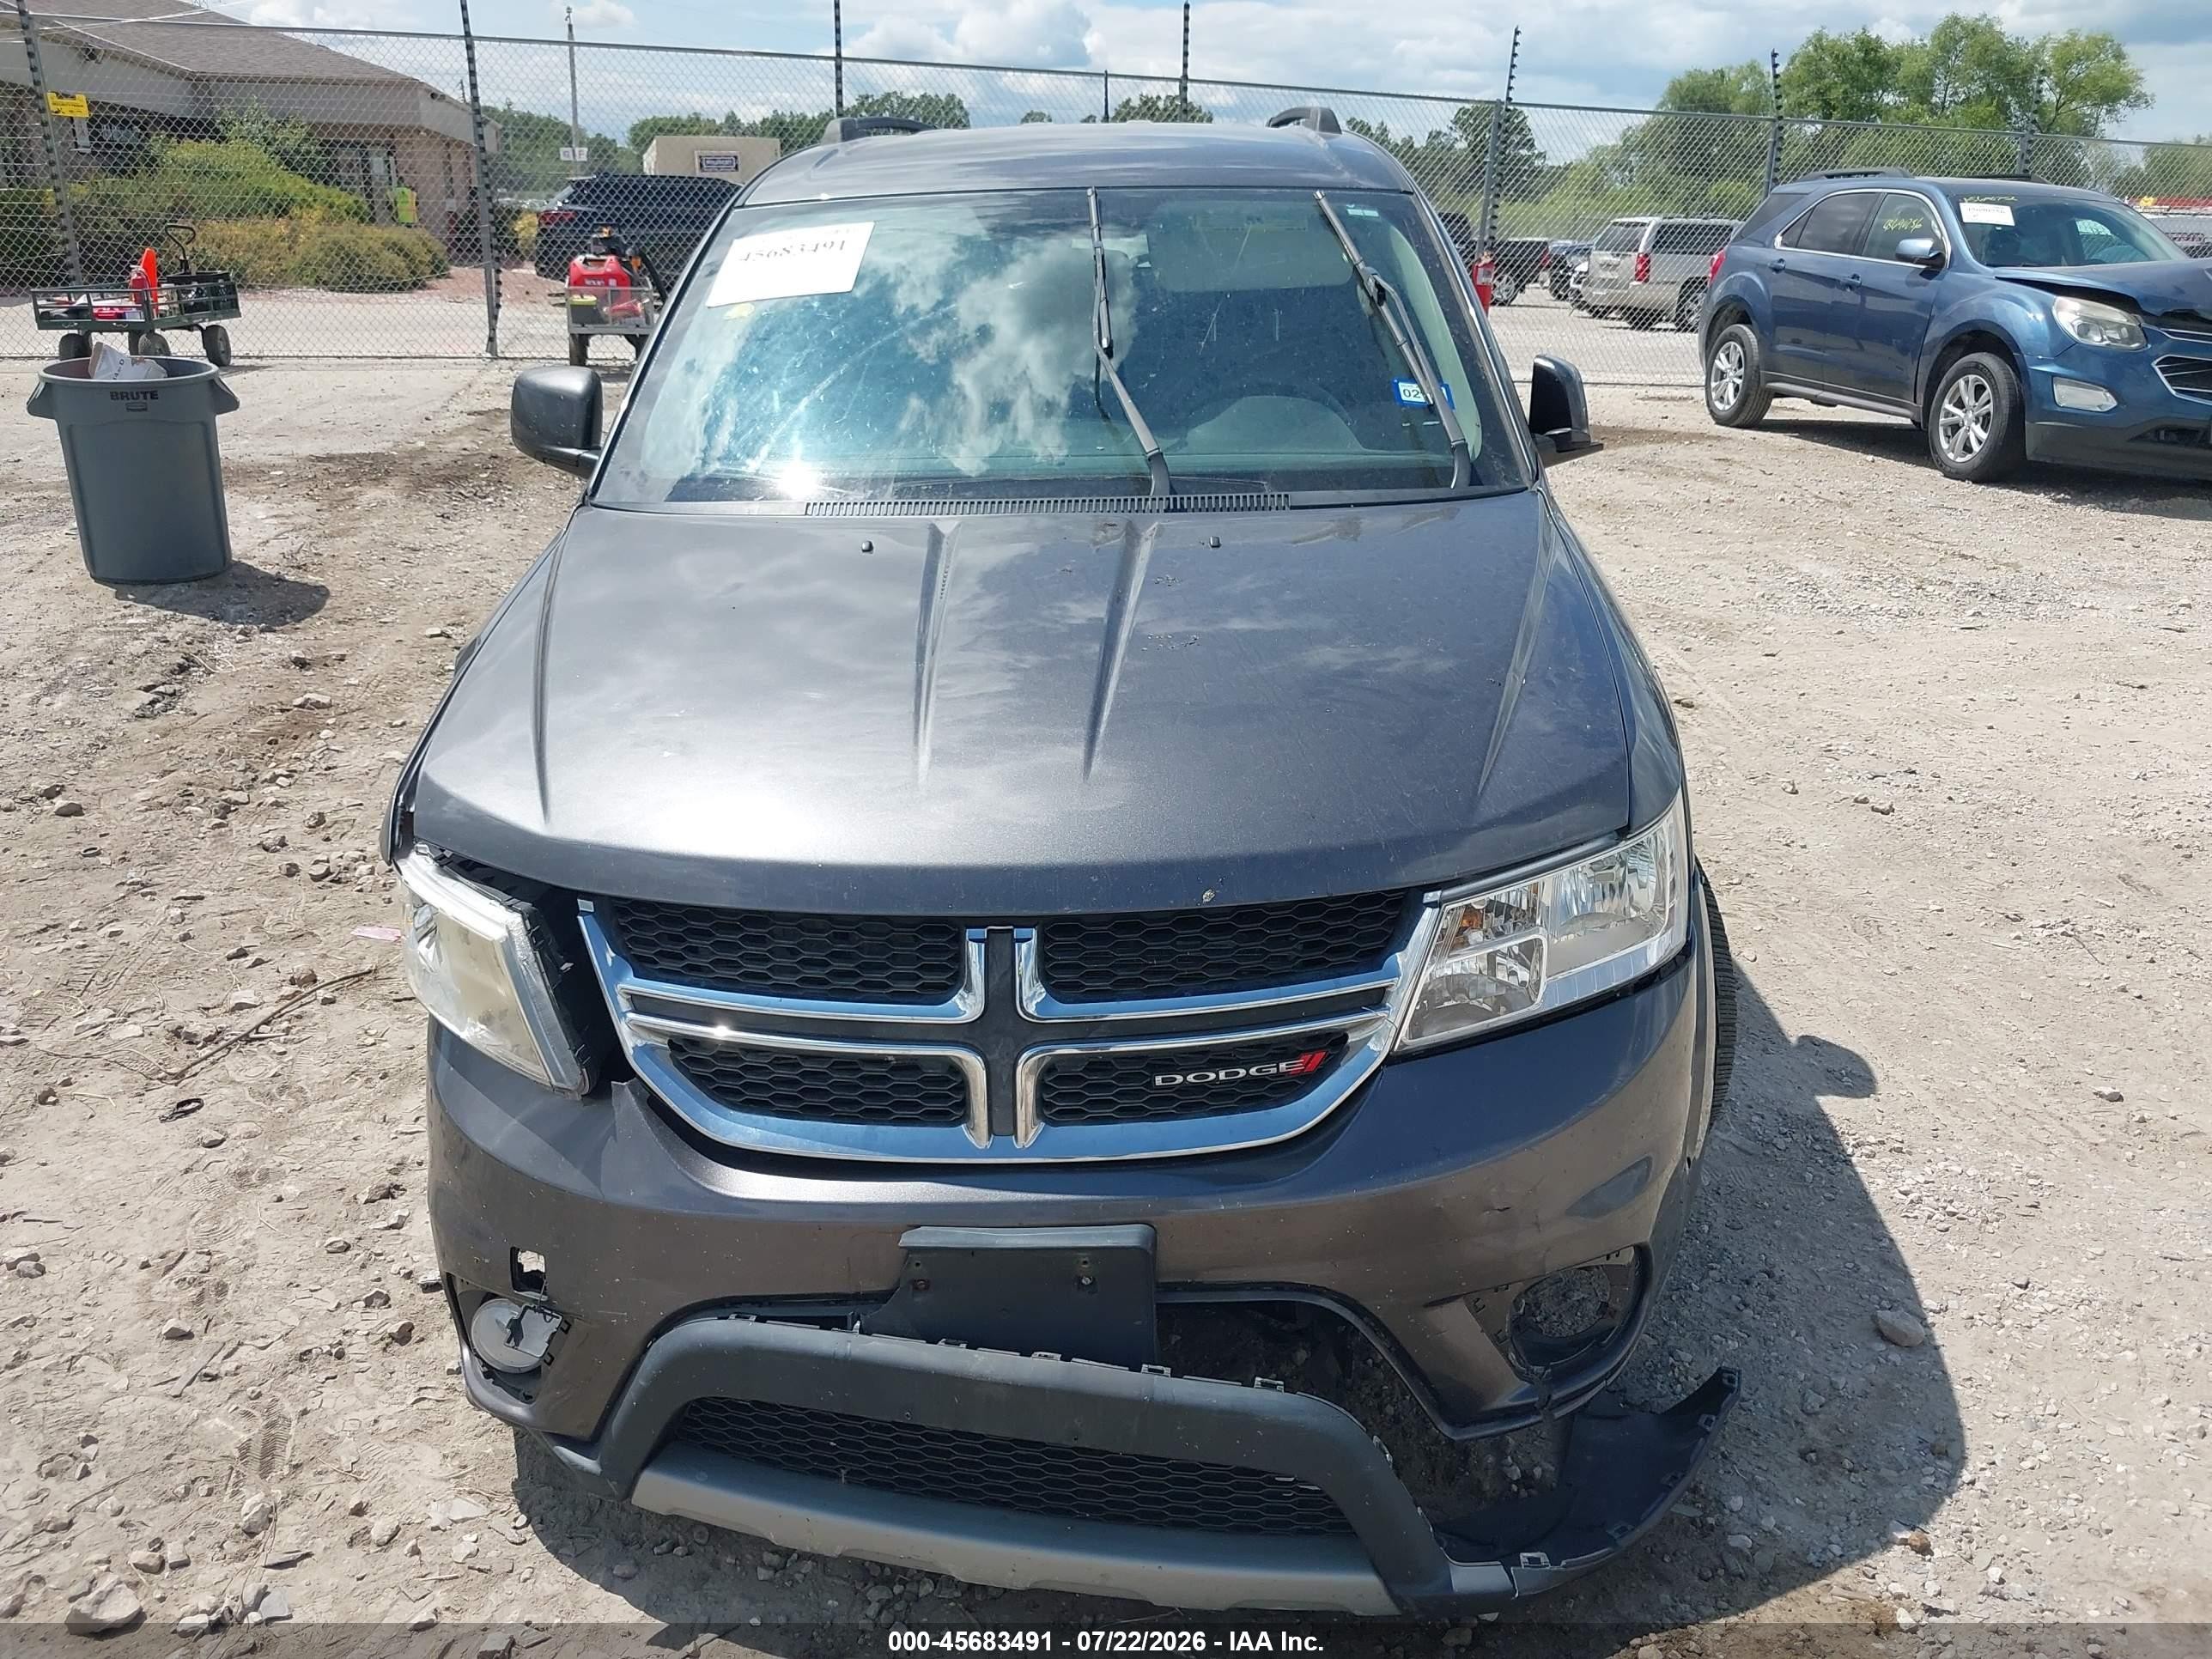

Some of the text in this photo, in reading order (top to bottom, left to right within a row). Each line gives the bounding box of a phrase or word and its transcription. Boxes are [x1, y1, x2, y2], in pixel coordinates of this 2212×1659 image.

[110, 390, 159, 401] BRUTE
[1402, 388, 1421, 398] 02
[1155, 1059, 1305, 1086] DODGE
